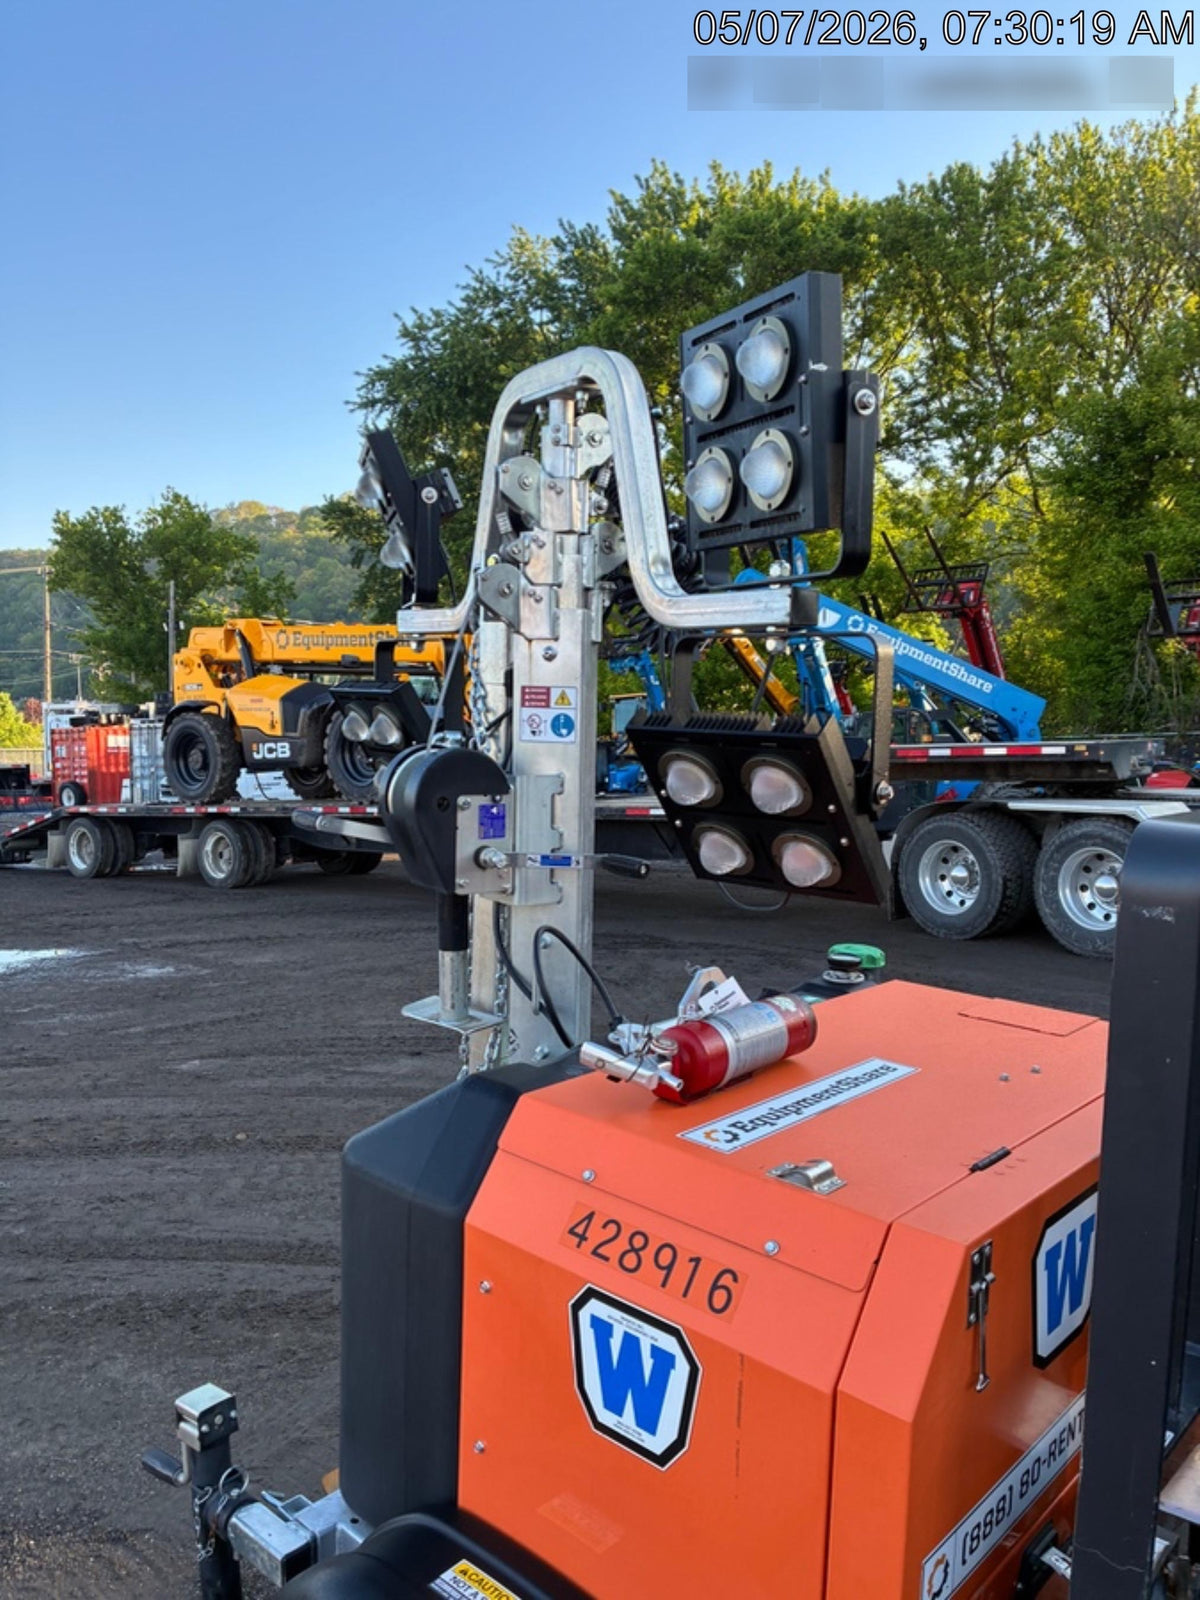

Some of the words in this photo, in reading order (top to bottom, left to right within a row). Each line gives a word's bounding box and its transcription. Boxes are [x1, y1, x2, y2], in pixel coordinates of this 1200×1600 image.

[866, 622, 994, 694] EuipmentShare
[252, 742, 291, 760] JCB
[732, 1064, 899, 1133] EquipmentShare
[567, 1210, 739, 1315] 428916
[1043, 1213, 1096, 1335] W
[590, 1313, 676, 1437] W
[961, 1484, 1014, 1566] (888)
[449, 1576, 472, 1592] NOT
